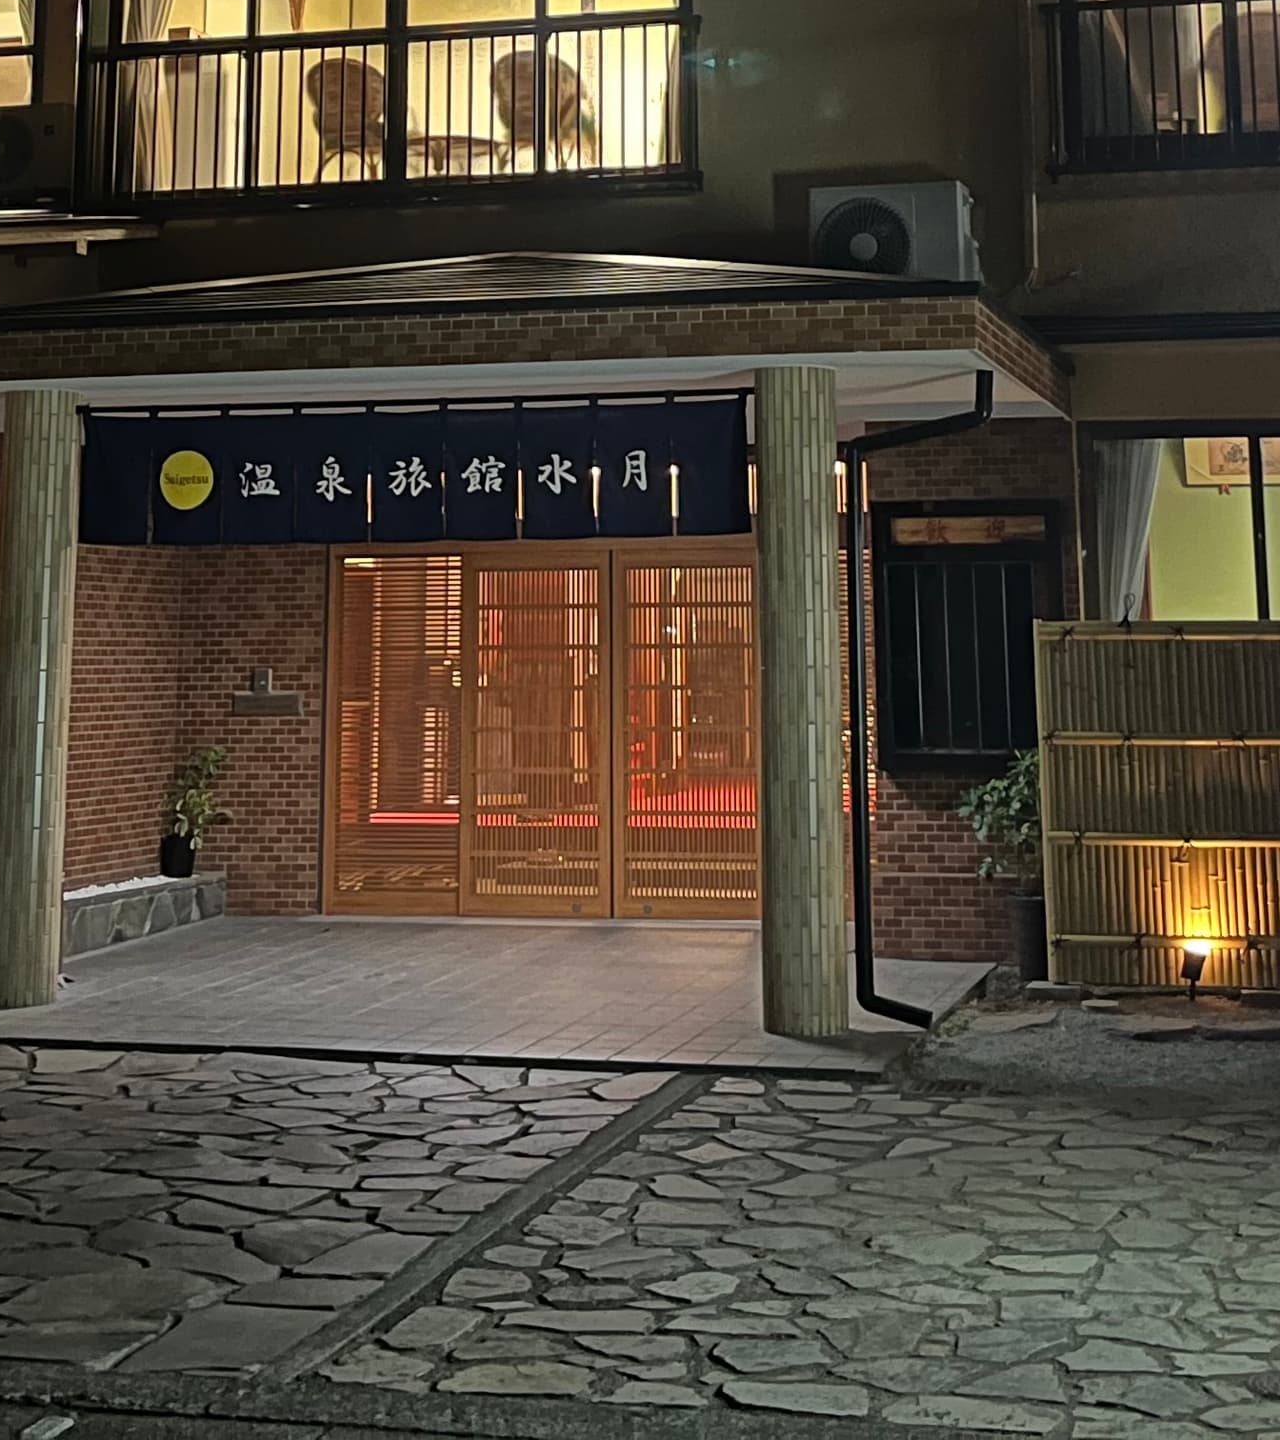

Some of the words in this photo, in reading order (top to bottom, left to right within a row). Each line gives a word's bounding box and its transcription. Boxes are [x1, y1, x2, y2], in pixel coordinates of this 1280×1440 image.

[238, 449, 648, 502] 温泉旅館水月
